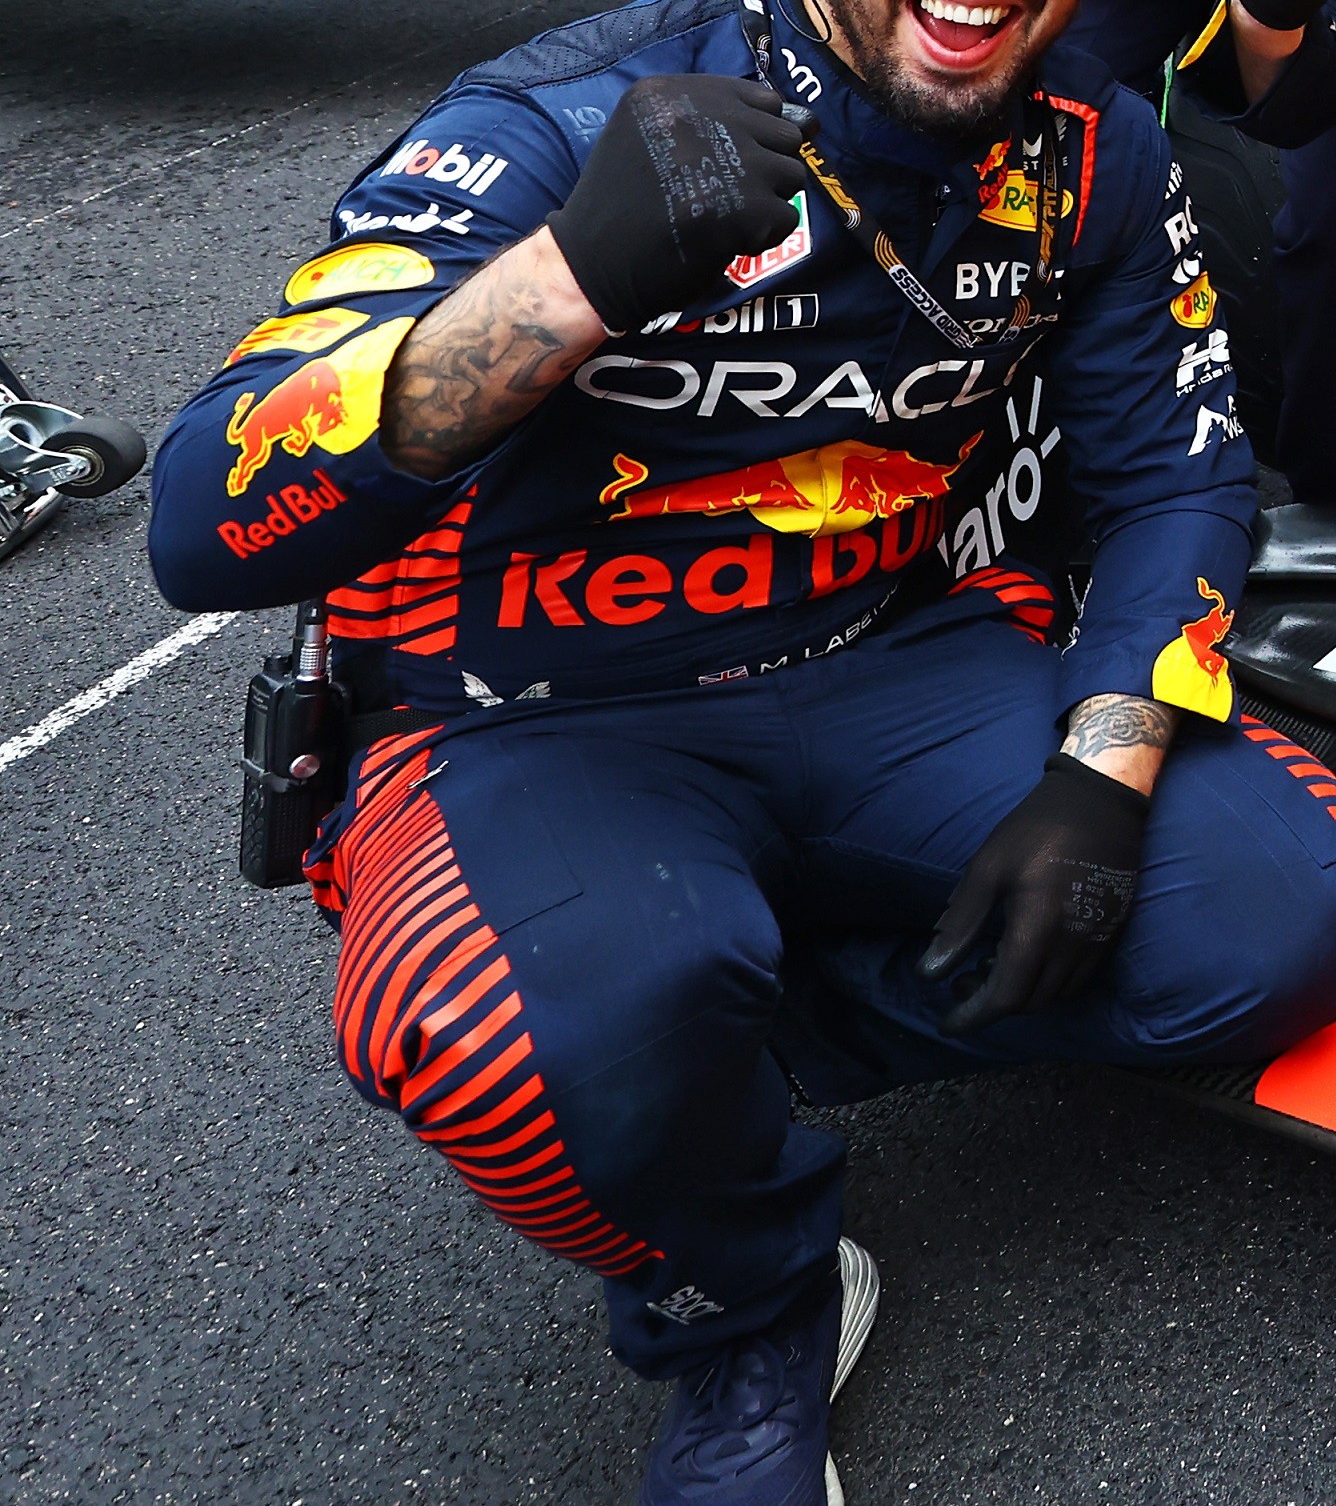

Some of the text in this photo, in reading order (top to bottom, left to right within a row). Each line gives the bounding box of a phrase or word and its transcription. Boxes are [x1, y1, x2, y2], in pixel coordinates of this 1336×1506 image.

[380, 137, 509, 196] Mobil
[890, 267, 943, 324] ACCESS
[574, 356, 998, 424] ORACL
[216, 503, 287, 561] Red
[498, 533, 773, 627] Red
